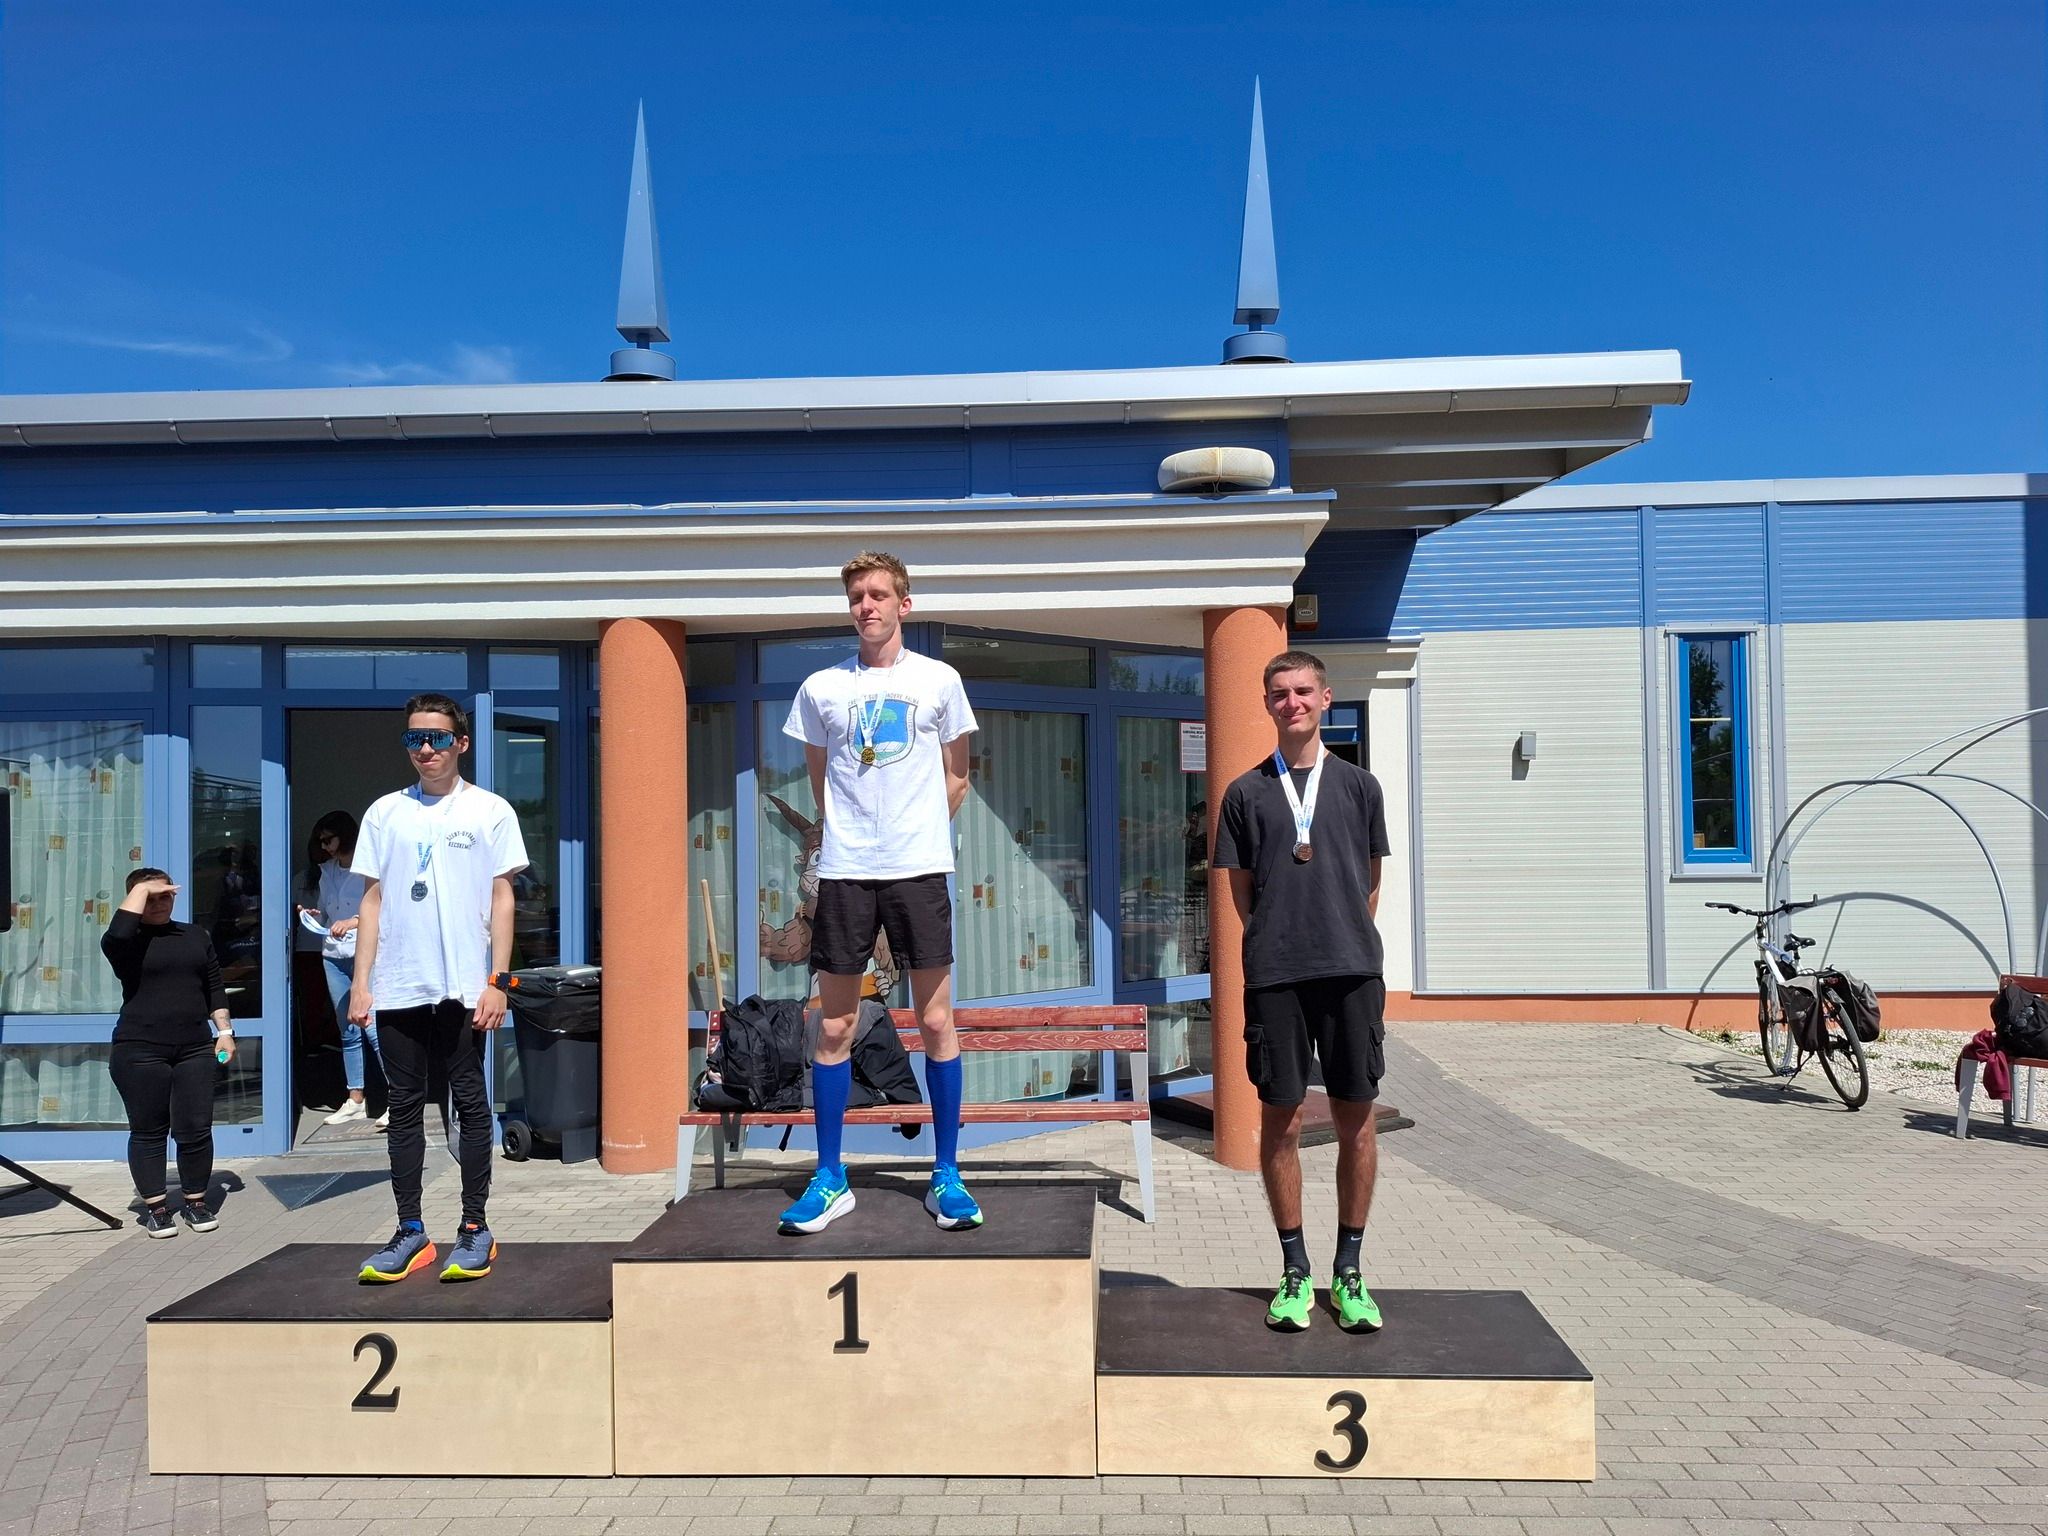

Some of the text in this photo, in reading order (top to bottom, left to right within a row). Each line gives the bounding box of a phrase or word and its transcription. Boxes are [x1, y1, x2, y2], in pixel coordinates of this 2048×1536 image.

[829, 1274, 869, 1354] 1
[352, 1332, 400, 1412] 2
[1316, 1390, 1369, 1469] 3
